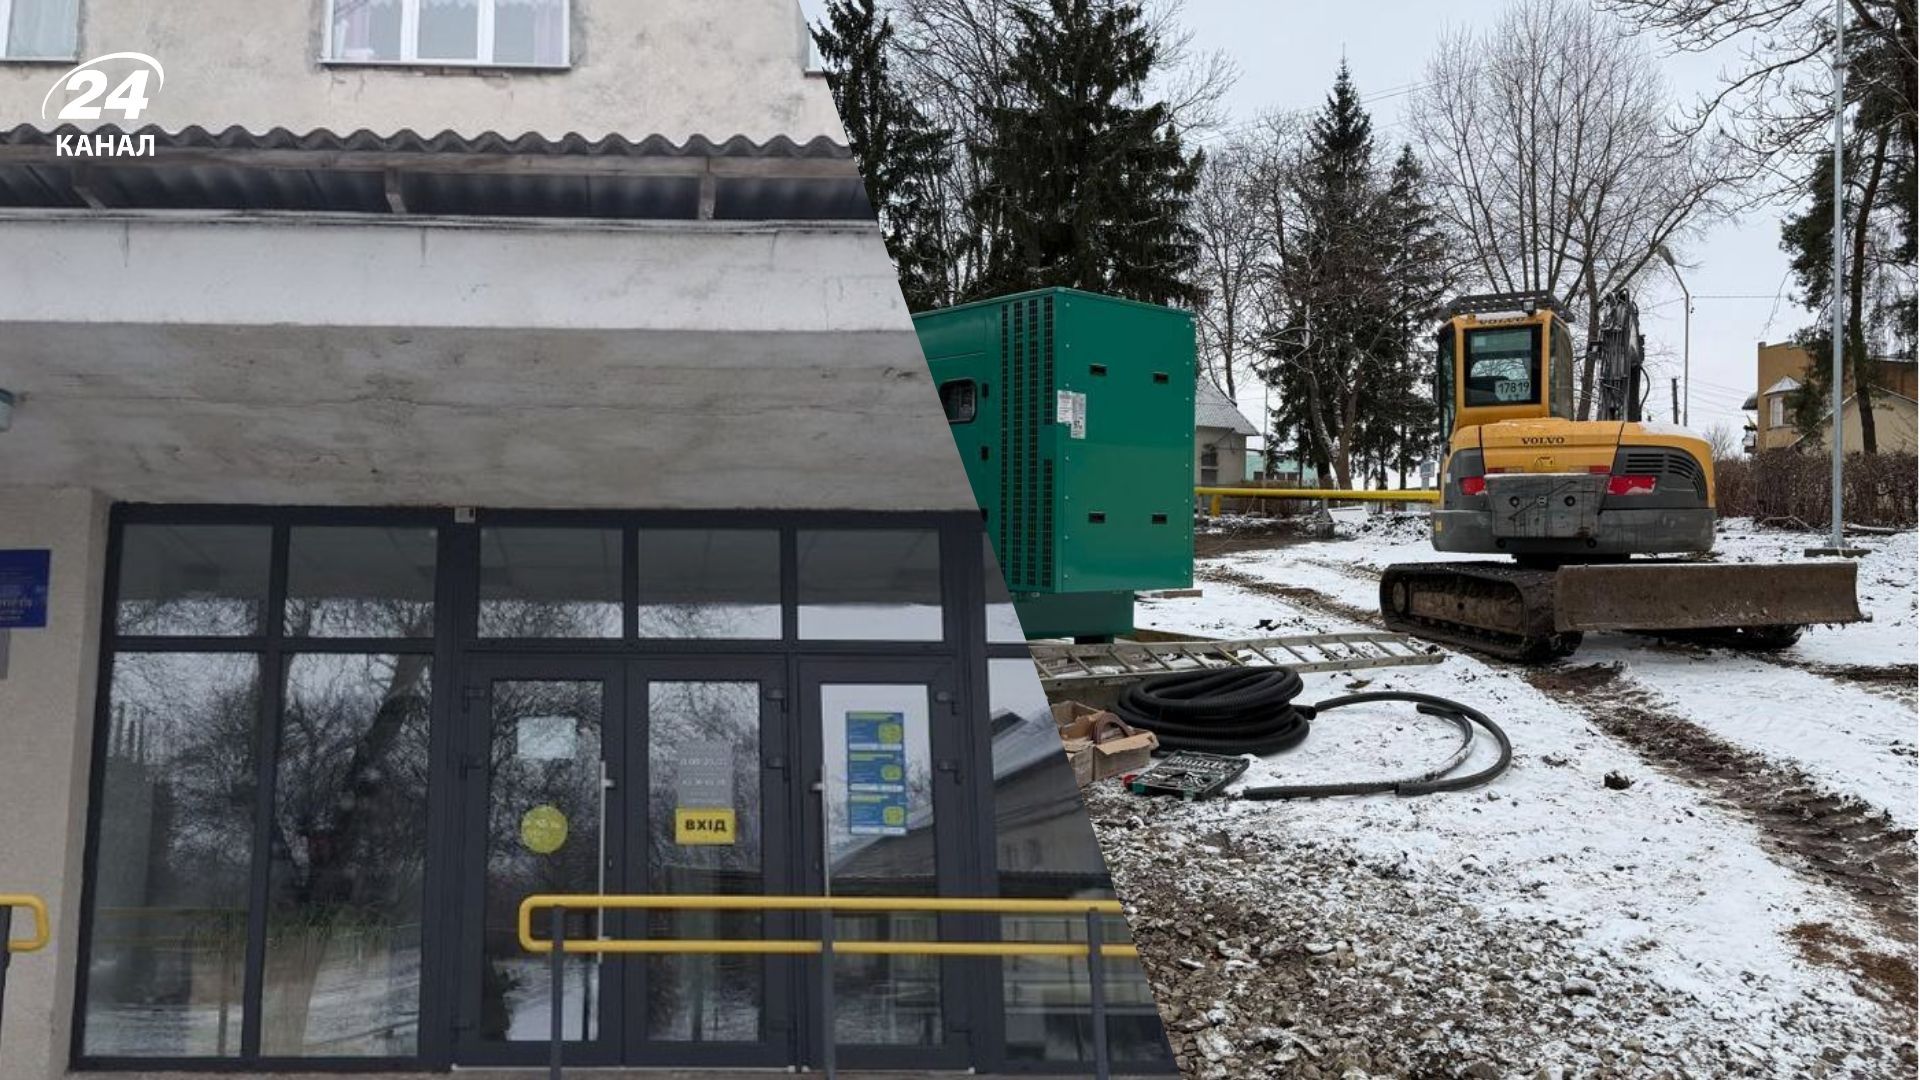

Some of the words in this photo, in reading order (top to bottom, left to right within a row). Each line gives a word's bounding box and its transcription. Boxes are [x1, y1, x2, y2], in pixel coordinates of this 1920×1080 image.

[1498, 381, 1529, 394] 17819
[1521, 436, 1565, 445] VOLVO
[685, 818, 727, 833] ВХІД
